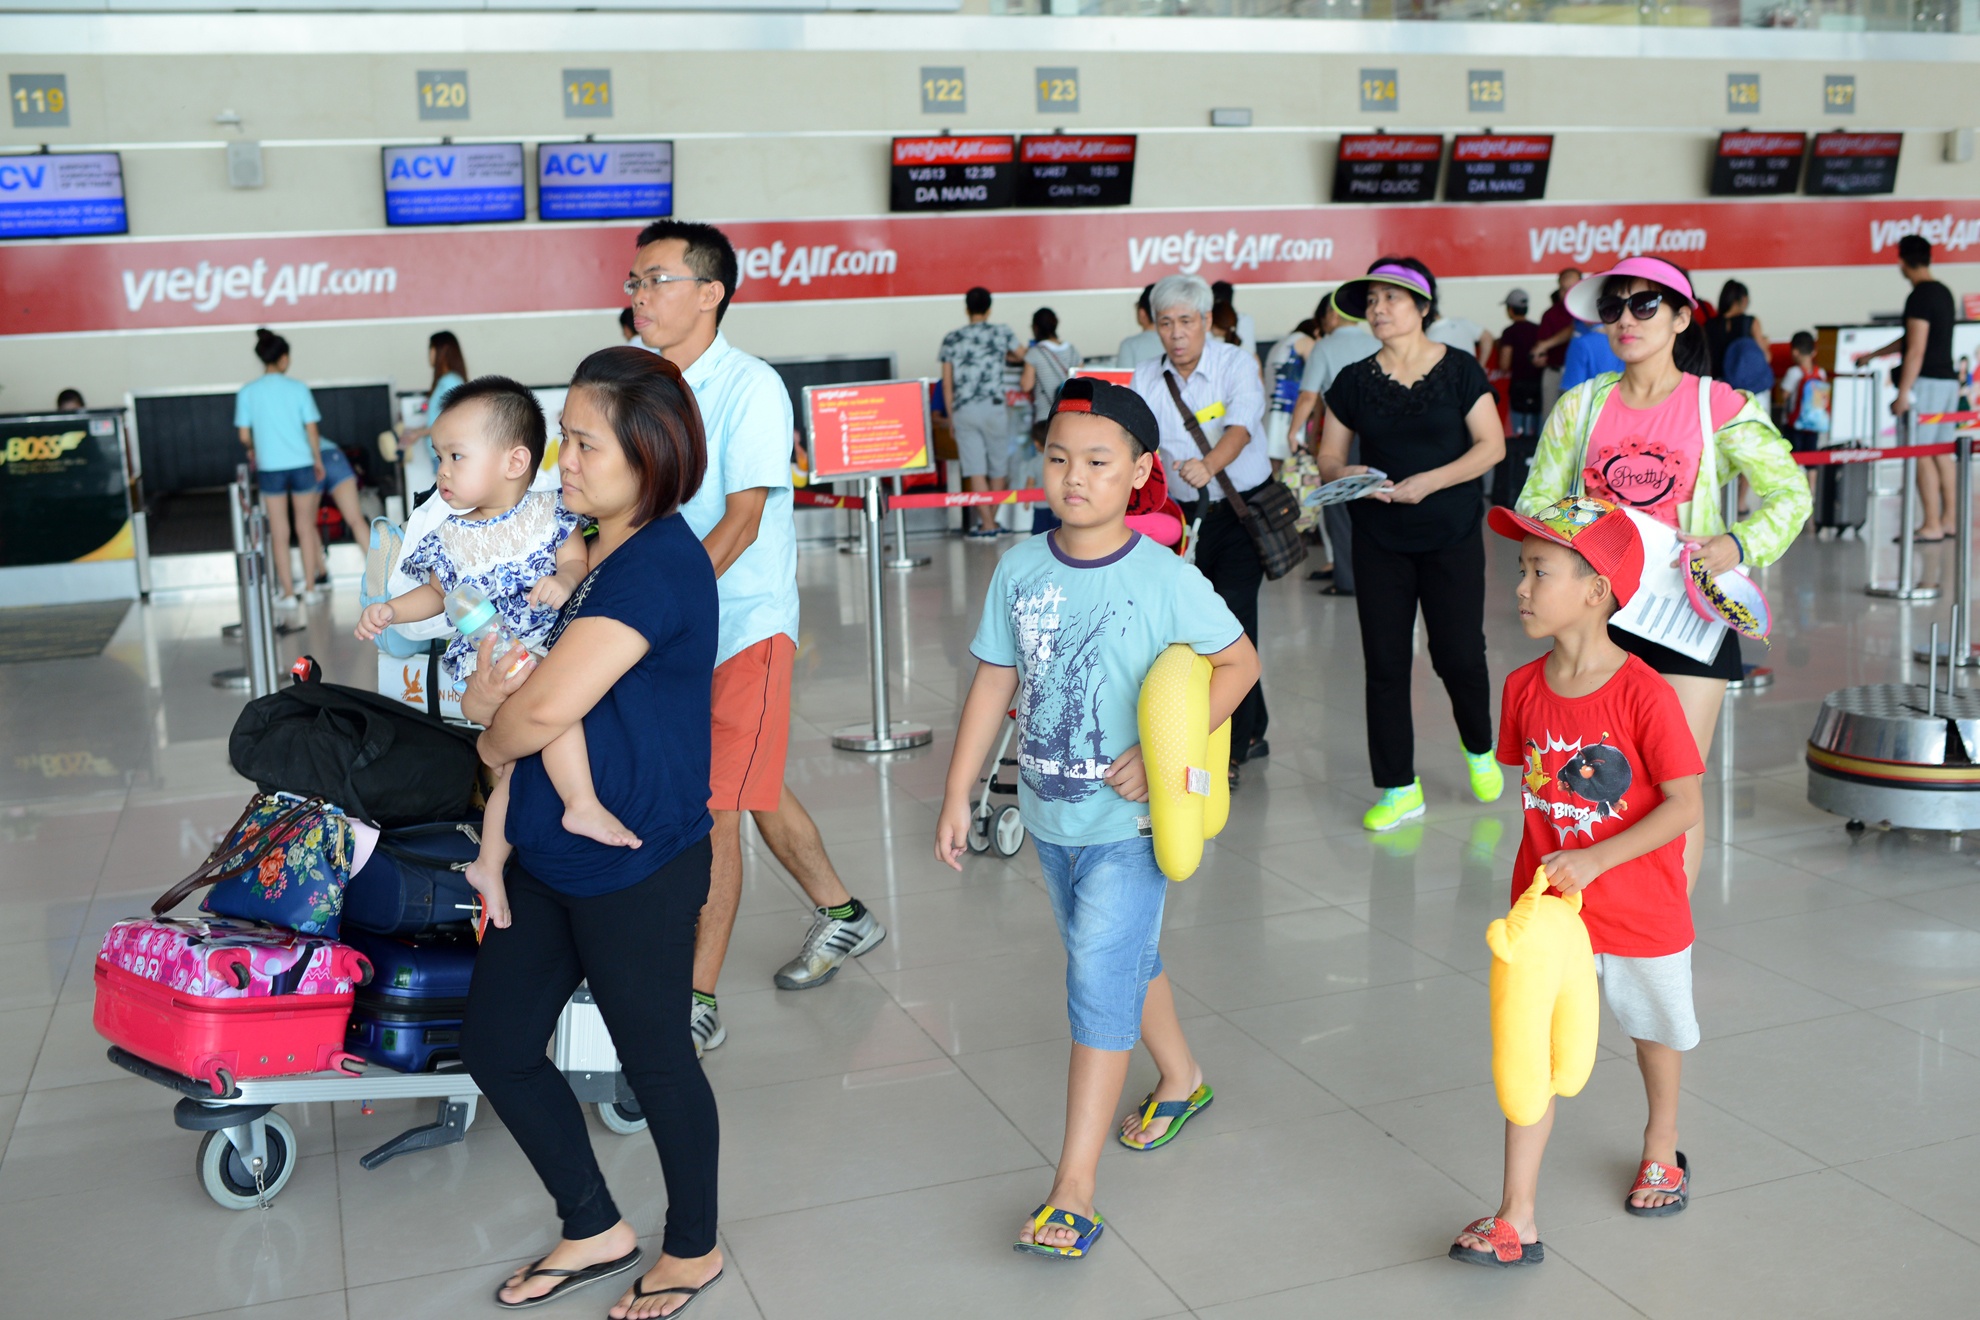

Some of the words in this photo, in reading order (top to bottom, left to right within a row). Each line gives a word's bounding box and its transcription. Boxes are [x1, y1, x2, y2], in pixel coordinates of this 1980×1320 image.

[14, 88, 65, 114] 119
[421, 83, 467, 108] 120
[567, 82, 610, 106] 121
[923, 79, 964, 102] 122
[1039, 79, 1077, 102] 123
[1361, 79, 1397, 102] 124
[1469, 80, 1503, 102] 125
[1825, 84, 1855, 106] 127
[390, 155, 455, 179] ACV
[544, 152, 608, 176] ACV
[915, 187, 939, 202] DA
[941, 185, 988, 202] NANG
[1467, 179, 1487, 194] DA
[1488, 178, 1525, 193] NANG
[1610, 465, 1667, 489] Pretty
[1551, 802, 1591, 821] BIRDS
